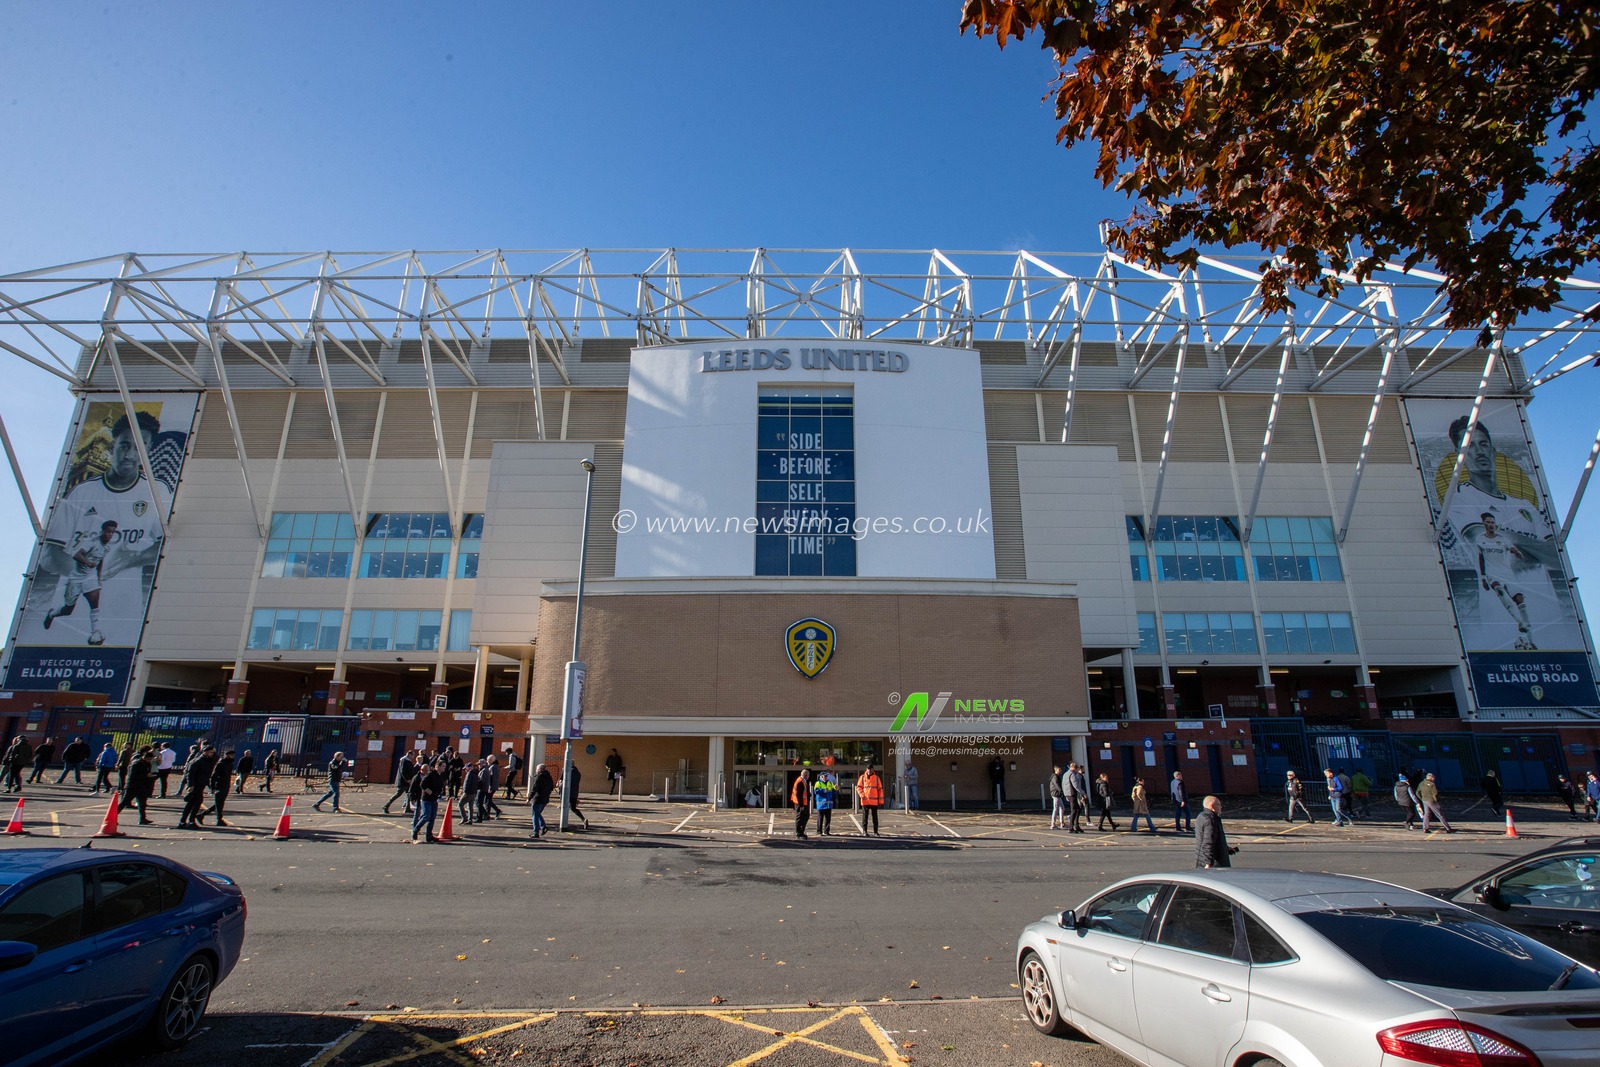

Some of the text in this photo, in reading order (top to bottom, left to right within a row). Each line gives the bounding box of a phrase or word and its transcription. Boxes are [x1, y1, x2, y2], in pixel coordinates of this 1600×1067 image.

[702, 348, 910, 372] LEEDS UNITED
[779, 457, 832, 475] BEFORE
[789, 483, 826, 503] SELF,
[40, 659, 102, 667] WELCOME TO
[1500, 664, 1546, 672] WELCOME
[21, 667, 115, 679] ELLAND ROAD
[1487, 673, 1579, 683] ELLAND ROAD
